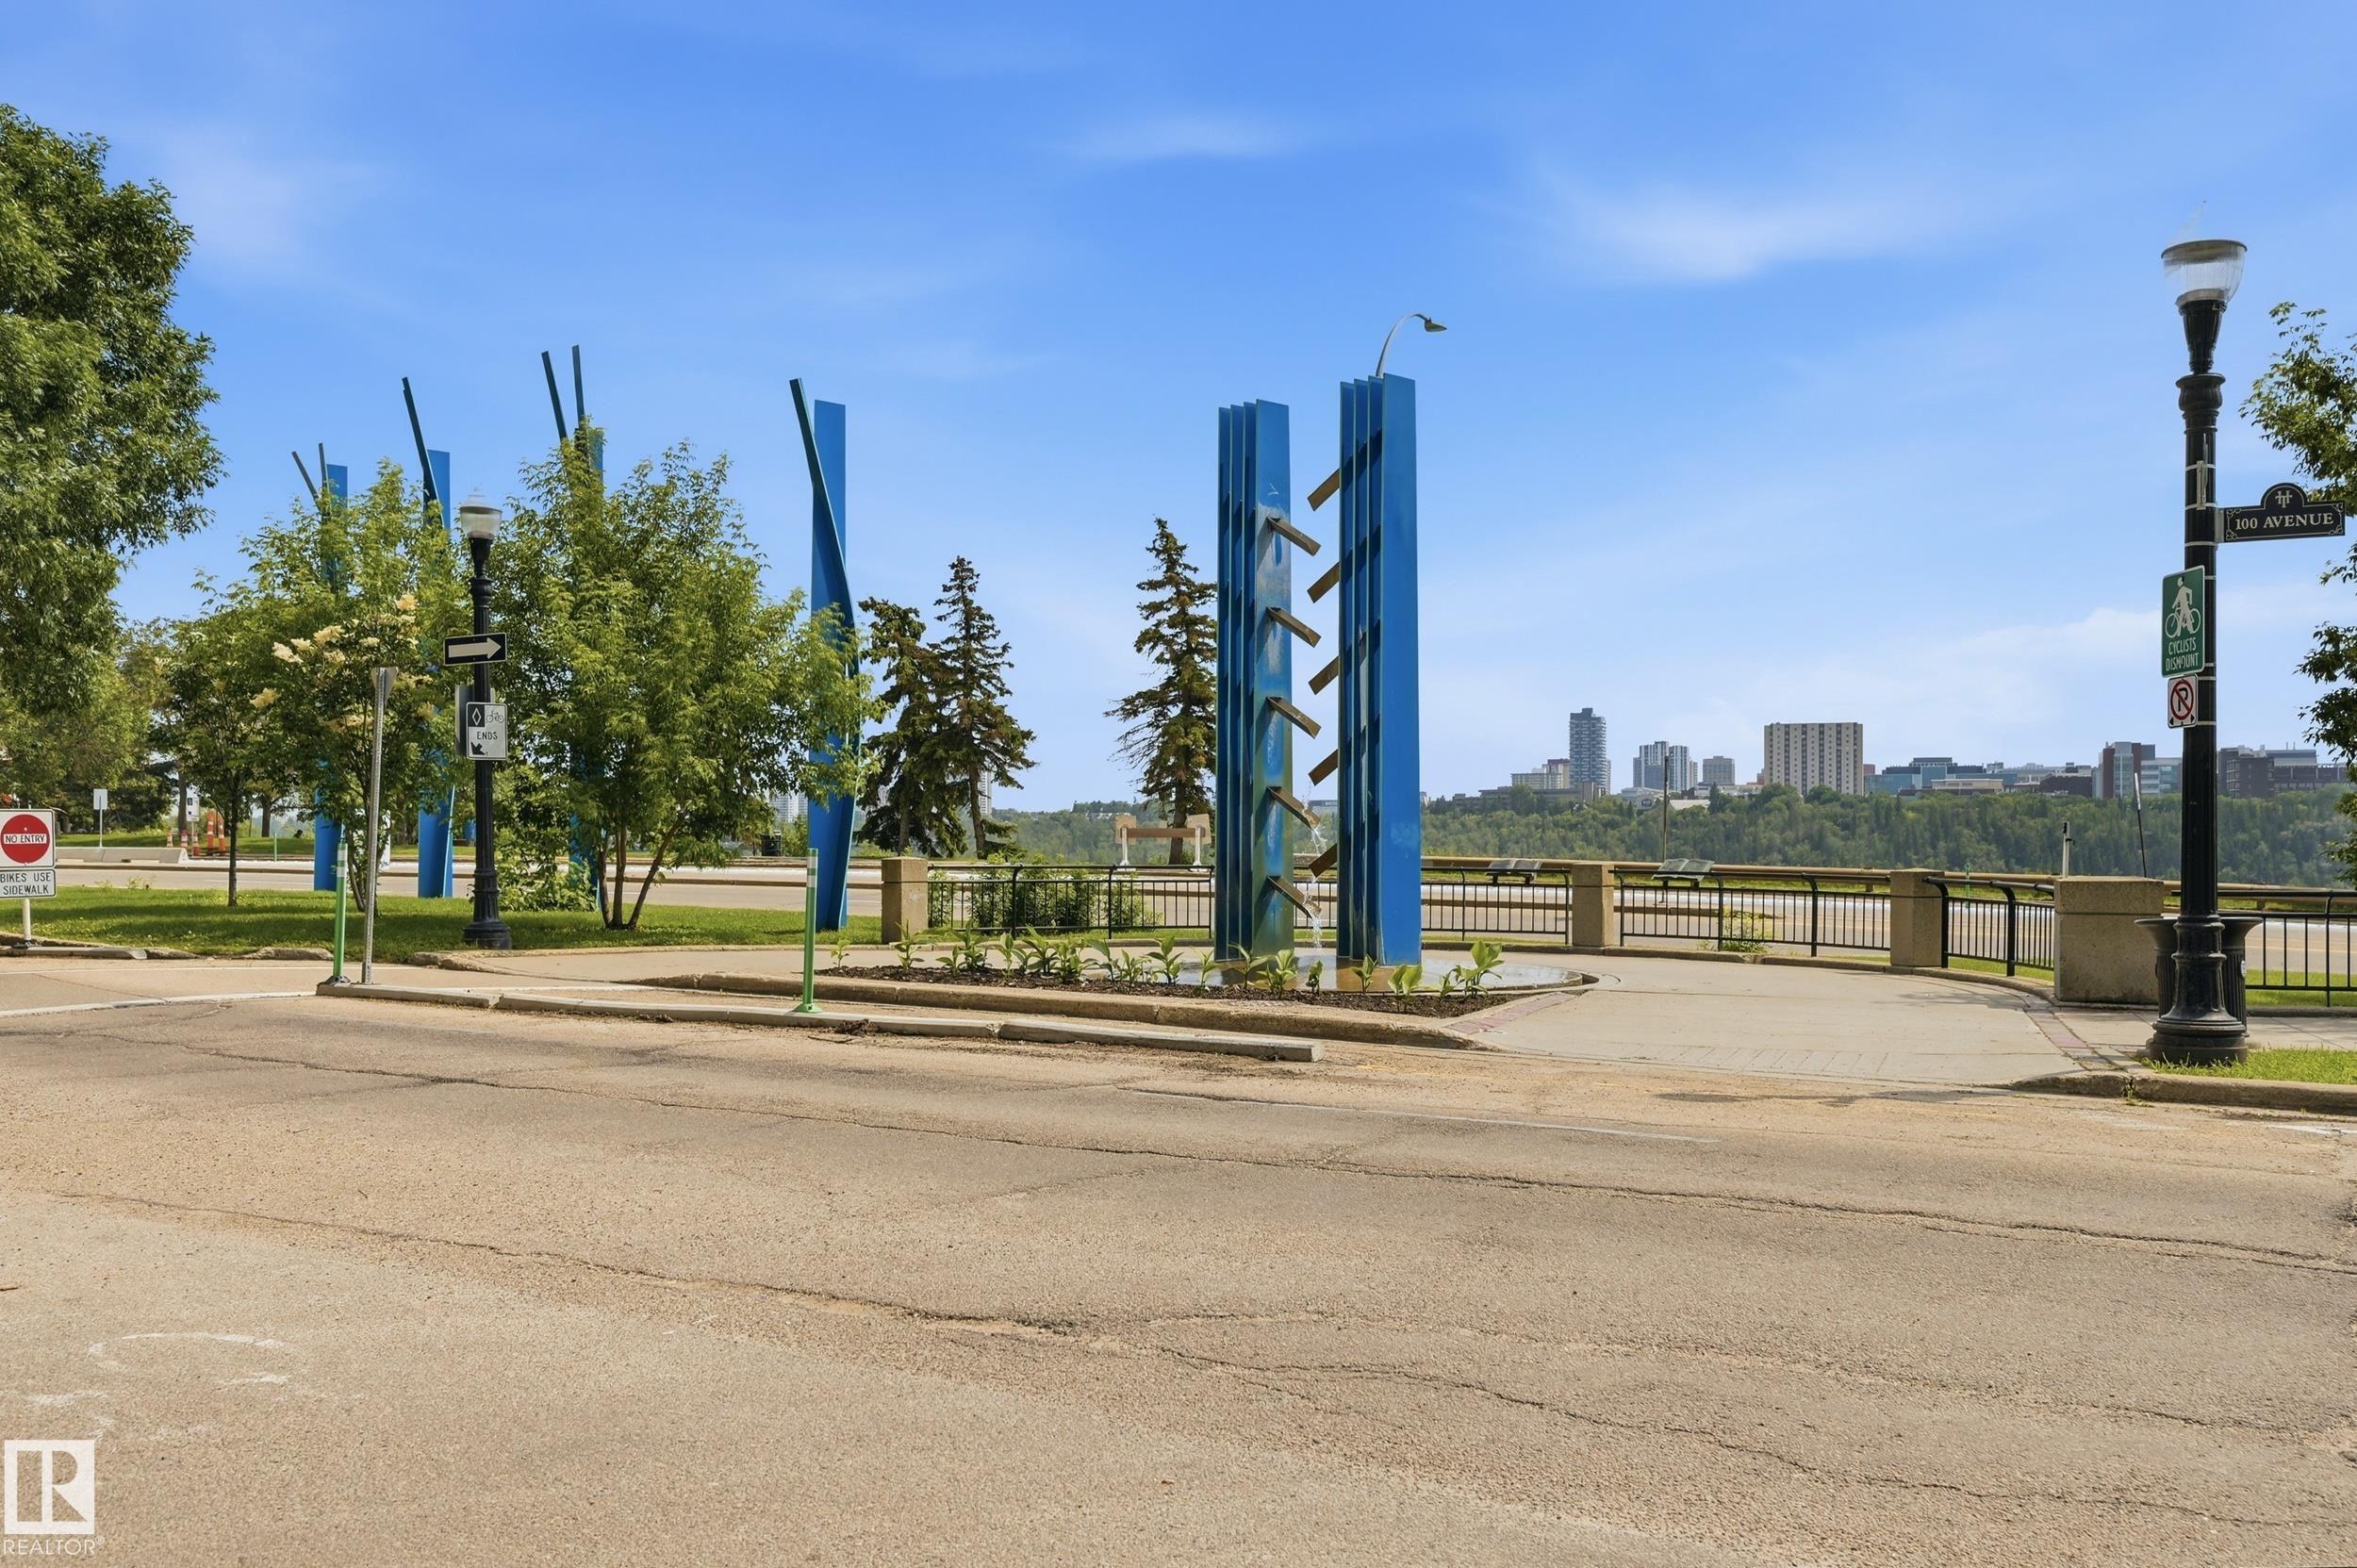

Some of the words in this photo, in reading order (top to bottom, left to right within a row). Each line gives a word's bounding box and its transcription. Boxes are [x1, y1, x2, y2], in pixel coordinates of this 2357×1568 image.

[2235, 518, 2258, 530] 100
[2263, 512, 2334, 528] AVENUE
[2168, 636, 2197, 655] CYCLISTS
[2166, 652, 2200, 671] DISMOUNT
[476, 732, 498, 740] ENDS
[5, 834, 18, 843] NO
[20, 834, 45, 843] ENTRY
[0, 872, 27, 883] BIKES
[33, 872, 51, 883] USE
[3, 884, 49, 895] SIDEWALK
